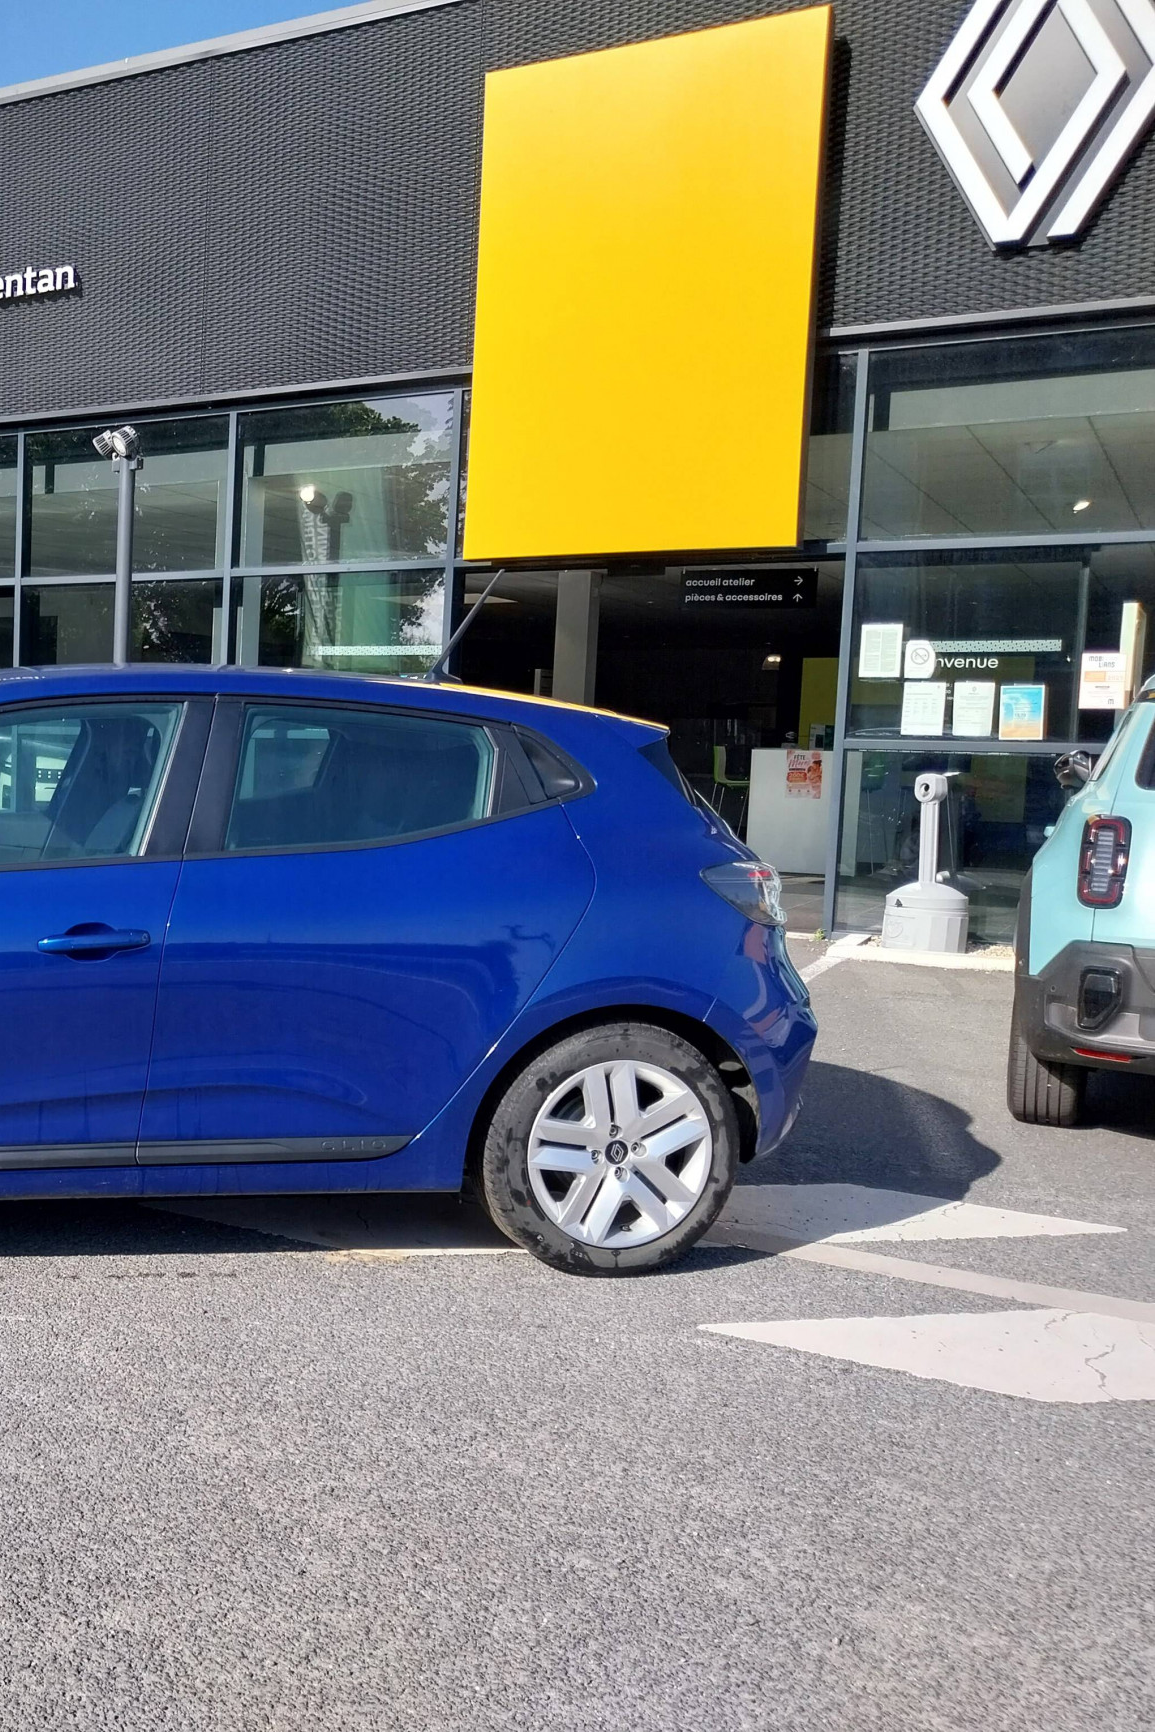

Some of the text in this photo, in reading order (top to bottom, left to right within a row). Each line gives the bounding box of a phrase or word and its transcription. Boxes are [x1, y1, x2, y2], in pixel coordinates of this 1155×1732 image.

[685, 577, 756, 587] accueil atelier
[685, 592, 783, 603] pièces & accessoires
[934, 657, 999, 669] nvenue
[321, 1139, 386, 1151] CLIO
